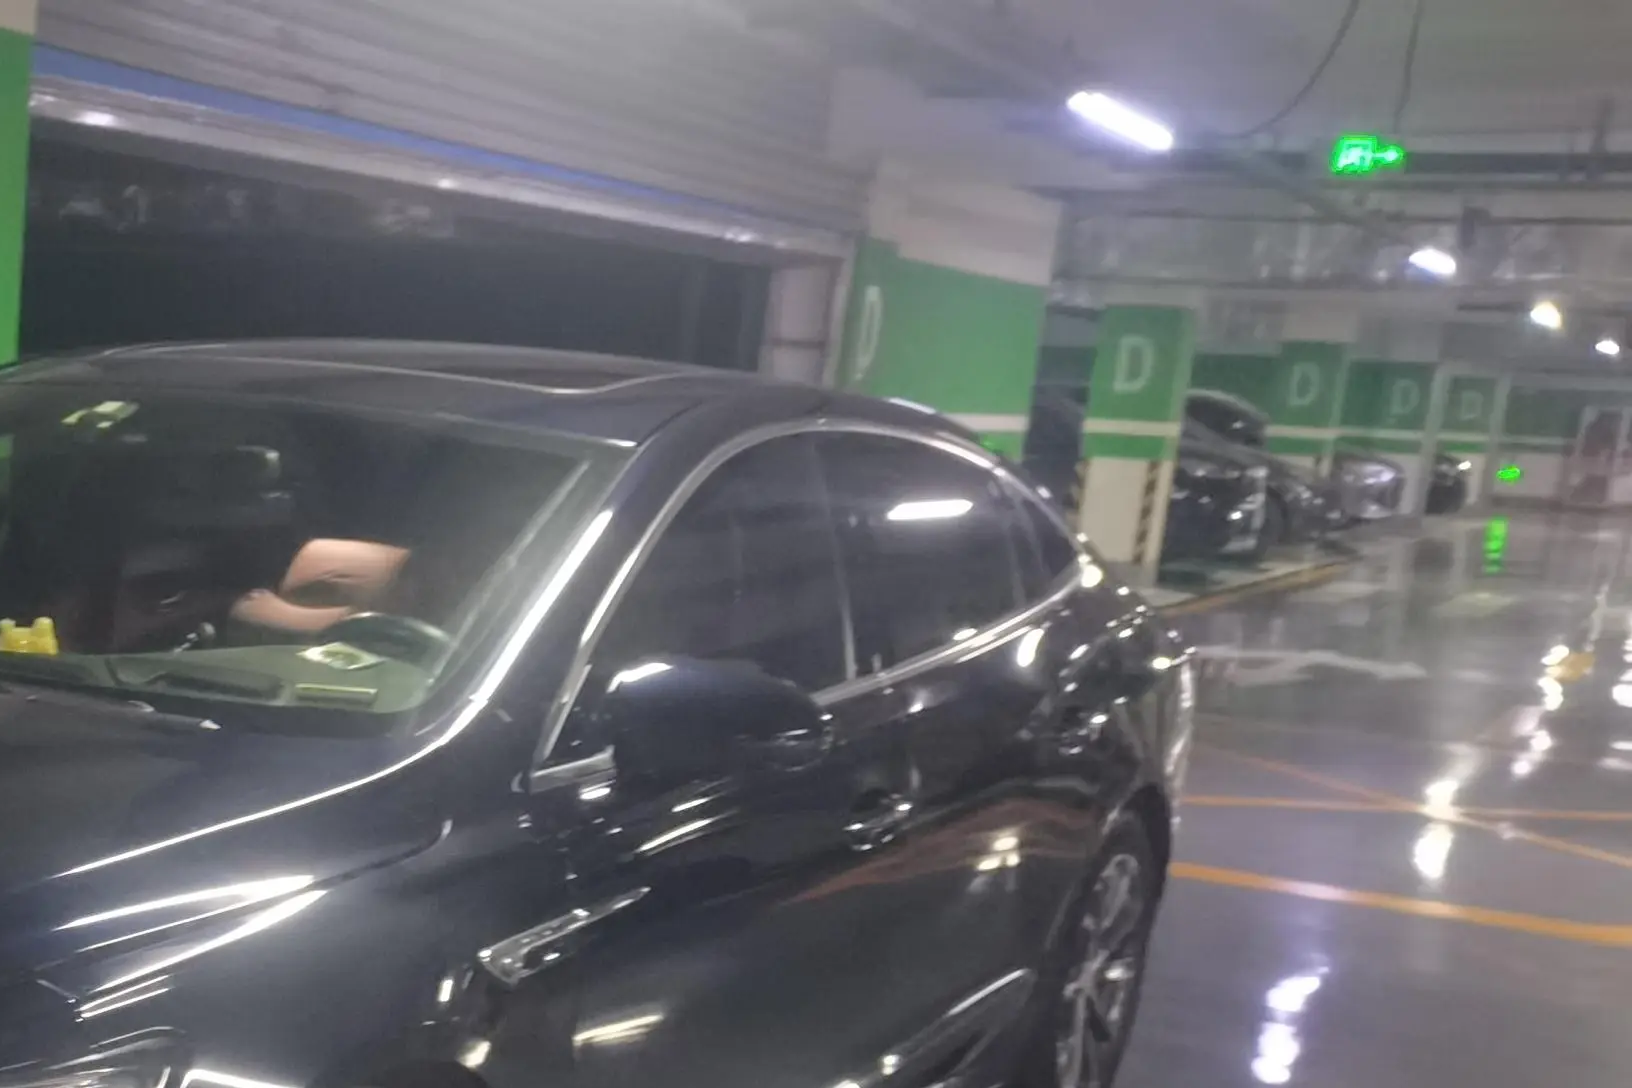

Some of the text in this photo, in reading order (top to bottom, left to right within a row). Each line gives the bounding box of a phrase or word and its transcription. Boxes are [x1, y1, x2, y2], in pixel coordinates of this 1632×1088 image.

[1112, 334, 1156, 393] D
[1287, 362, 1319, 406] D
[1390, 378, 1421, 416] D
